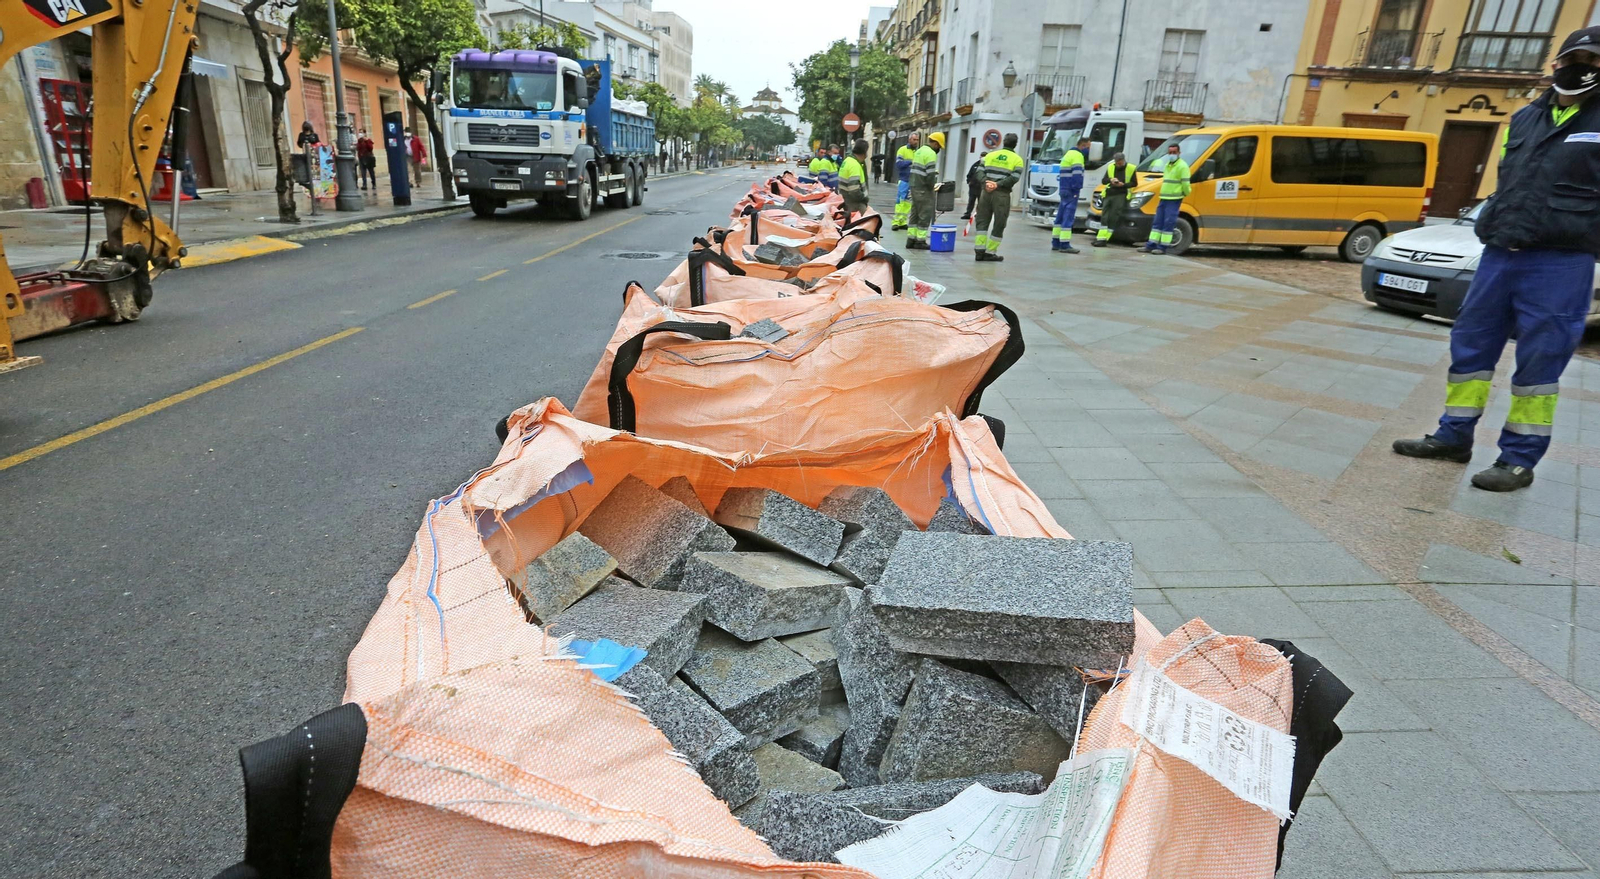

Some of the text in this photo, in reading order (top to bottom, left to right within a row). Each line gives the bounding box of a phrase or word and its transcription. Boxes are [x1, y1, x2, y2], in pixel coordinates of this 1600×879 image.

[1384, 276, 1425, 291] 5941 CGT
[1050, 774, 1071, 830] INSPECTION
